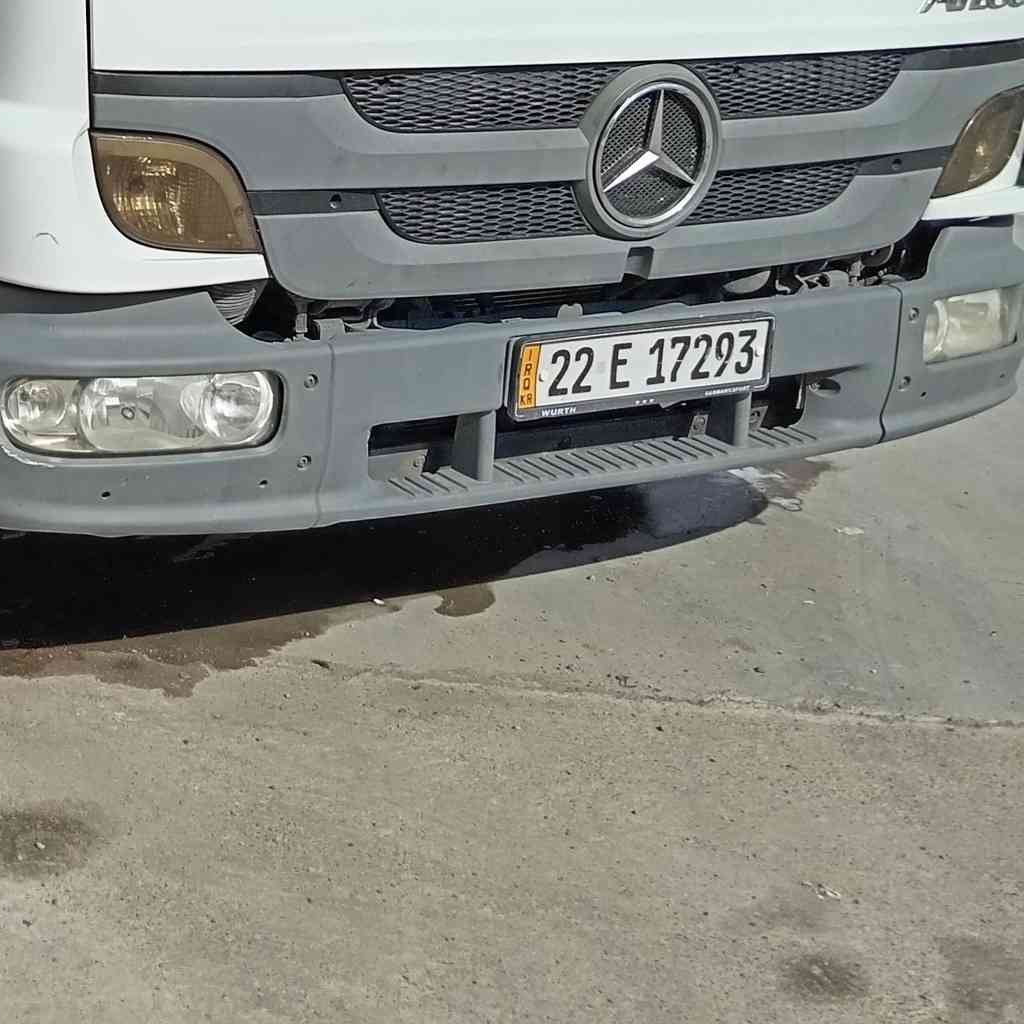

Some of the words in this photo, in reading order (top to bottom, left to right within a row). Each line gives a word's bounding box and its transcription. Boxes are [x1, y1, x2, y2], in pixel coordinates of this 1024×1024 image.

[548, 347, 594, 397] 22
[609, 342, 633, 390] E
[646, 329, 757, 385] 17293
